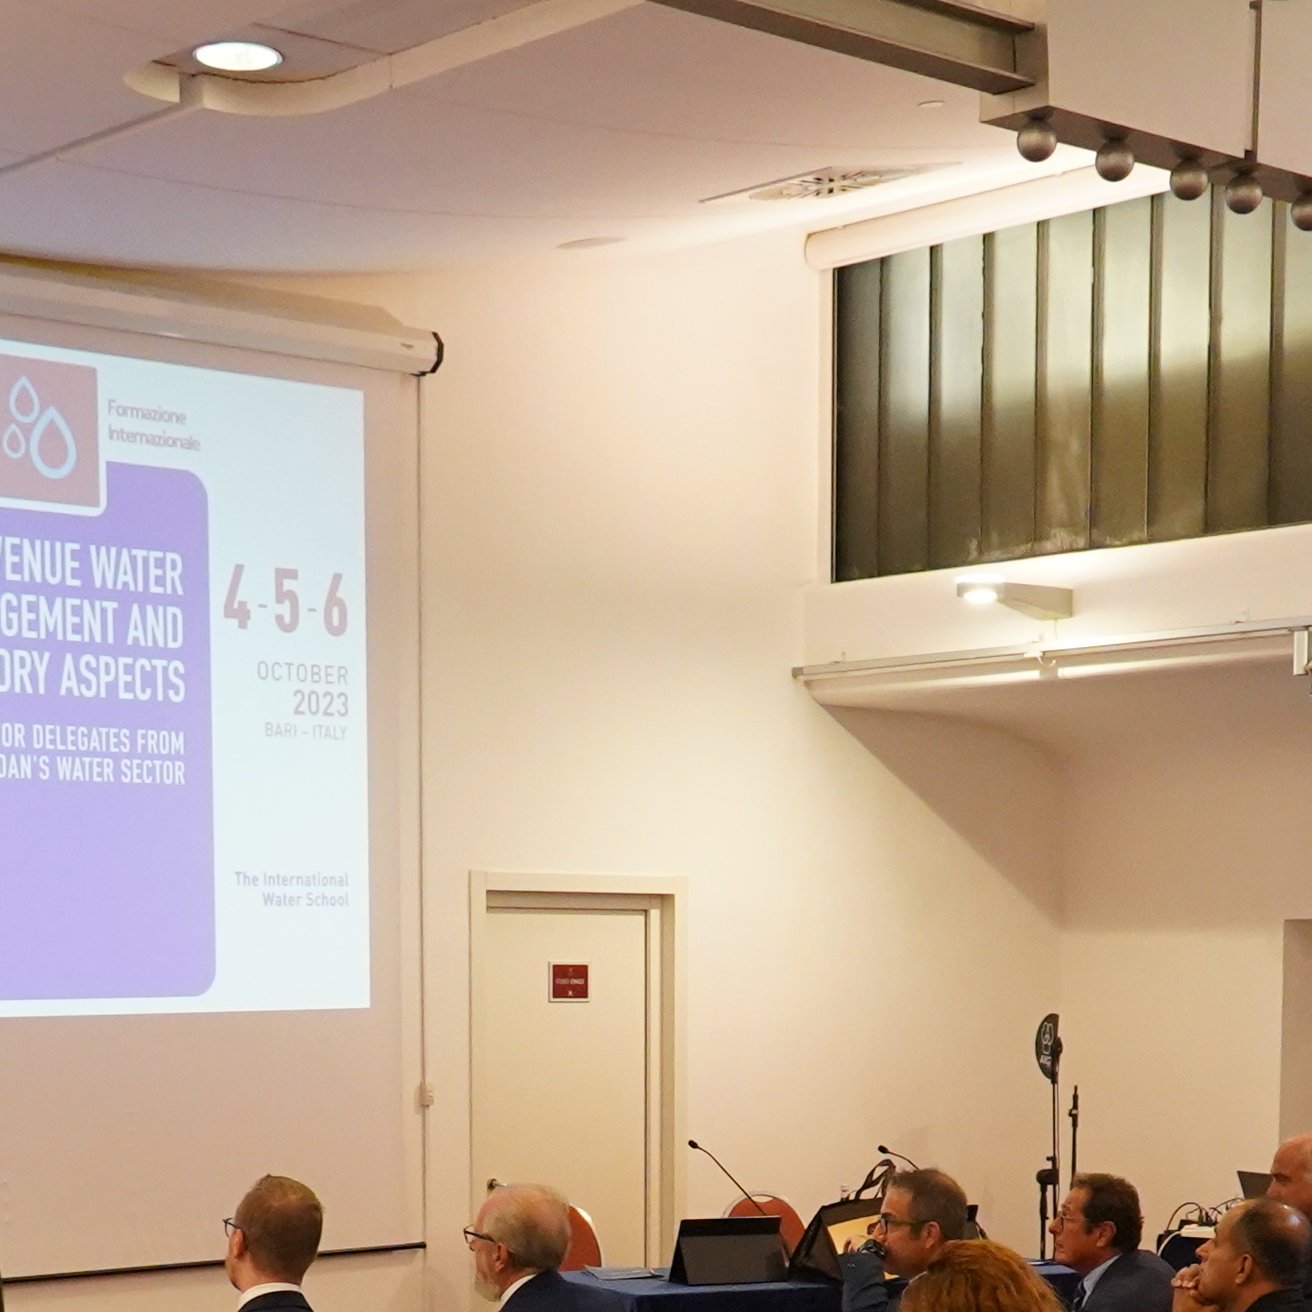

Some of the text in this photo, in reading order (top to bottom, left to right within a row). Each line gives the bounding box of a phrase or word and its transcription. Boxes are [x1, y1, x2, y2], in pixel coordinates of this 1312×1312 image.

[108, 399, 186, 425] Formazione
[109, 424, 200, 452] Internazionale
[89, 544, 184, 596] WATER
[127, 602, 184, 649] AND
[59, 652, 185, 703] ASPECTS
[257, 660, 349, 685] OCTOBER
[293, 689, 349, 717] 2023
[33, 724, 130, 753] DELEGATES
[137, 728, 185, 755] FROM
[265, 722, 297, 738] BARI
[313, 724, 348, 740] ITALY
[56, 755, 114, 783] WATER
[121, 758, 186, 785] SECTOR
[234, 871, 349, 887] The International
[262, 891, 349, 907] Water School
